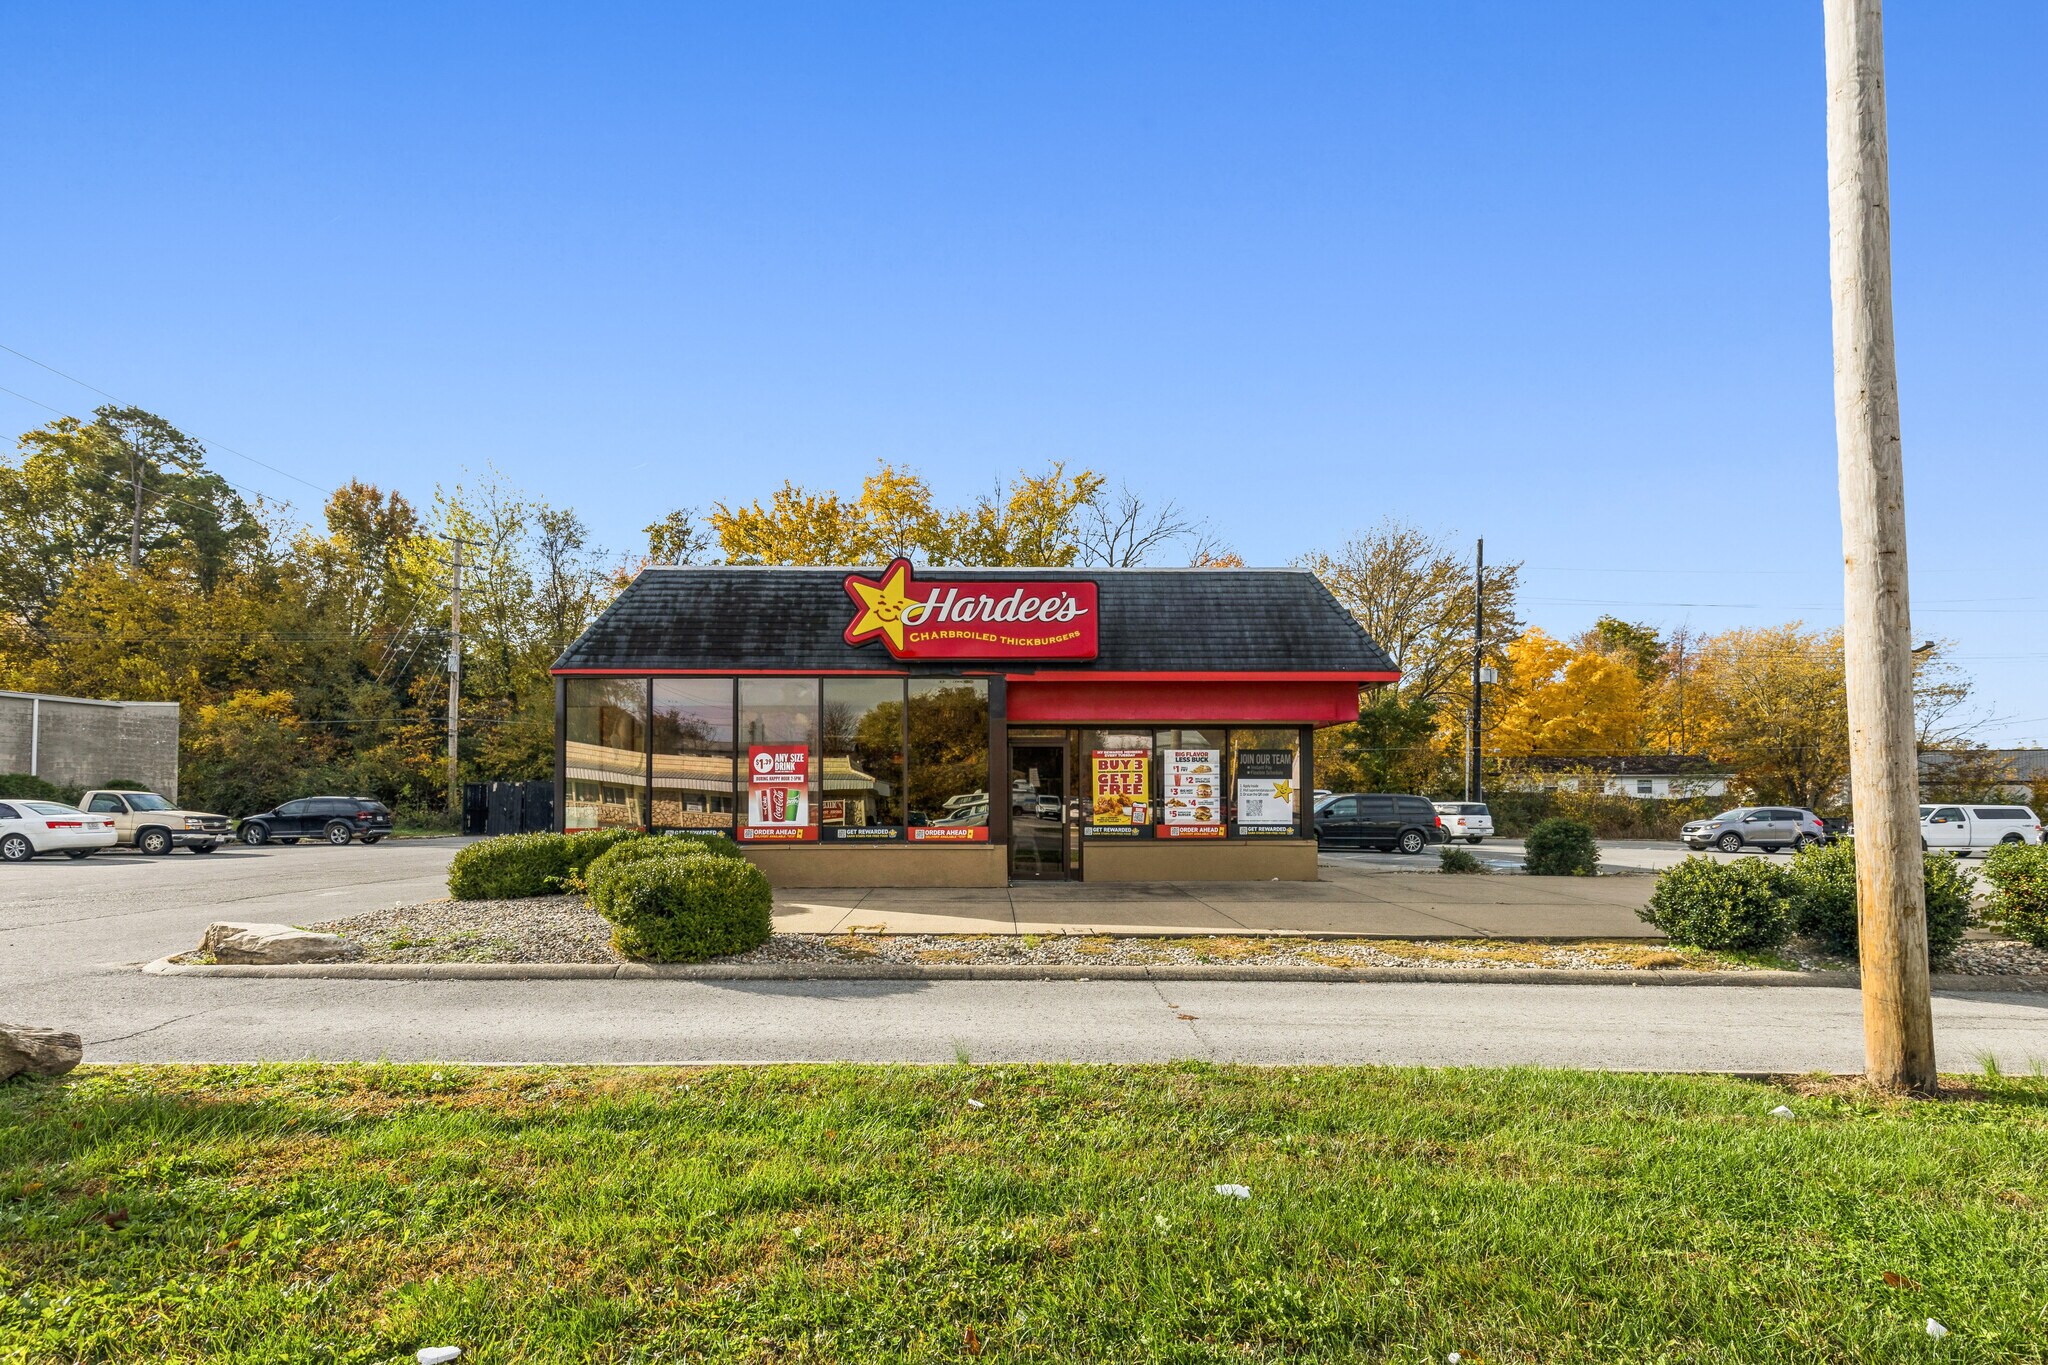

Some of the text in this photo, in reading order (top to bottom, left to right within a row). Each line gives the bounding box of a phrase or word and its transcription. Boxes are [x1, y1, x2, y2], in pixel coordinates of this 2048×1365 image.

[900, 588, 1088, 626] Hardee's
[909, 630, 1081, 646] CHARBROILED THICKBURGERS
[775, 753, 804, 763] ANY SIZE
[1240, 754, 1291, 764] JOIN OUR TEAM
[775, 762, 795, 771] DRINK
[1098, 760, 1143, 770] BUY 3
[1098, 774, 1143, 784] GET 3
[1099, 784, 1143, 795] FREE
